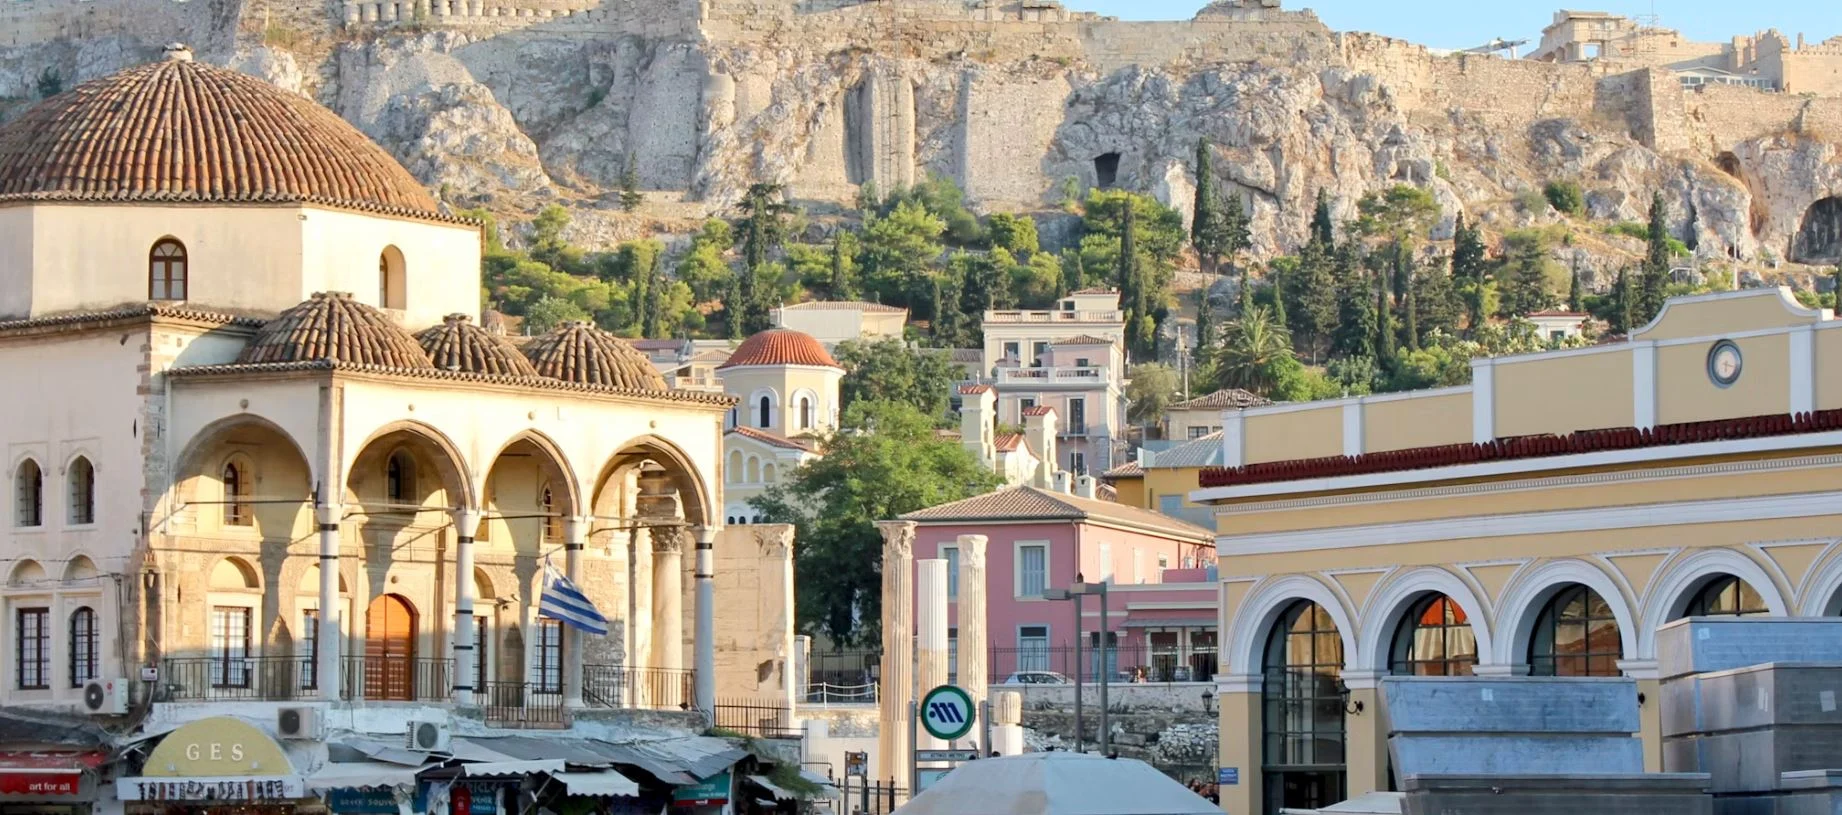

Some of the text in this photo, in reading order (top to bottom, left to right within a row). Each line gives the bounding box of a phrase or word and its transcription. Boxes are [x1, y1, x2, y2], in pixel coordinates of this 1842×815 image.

[186, 743, 244, 761] GES
[29, 782, 70, 791] art for all
